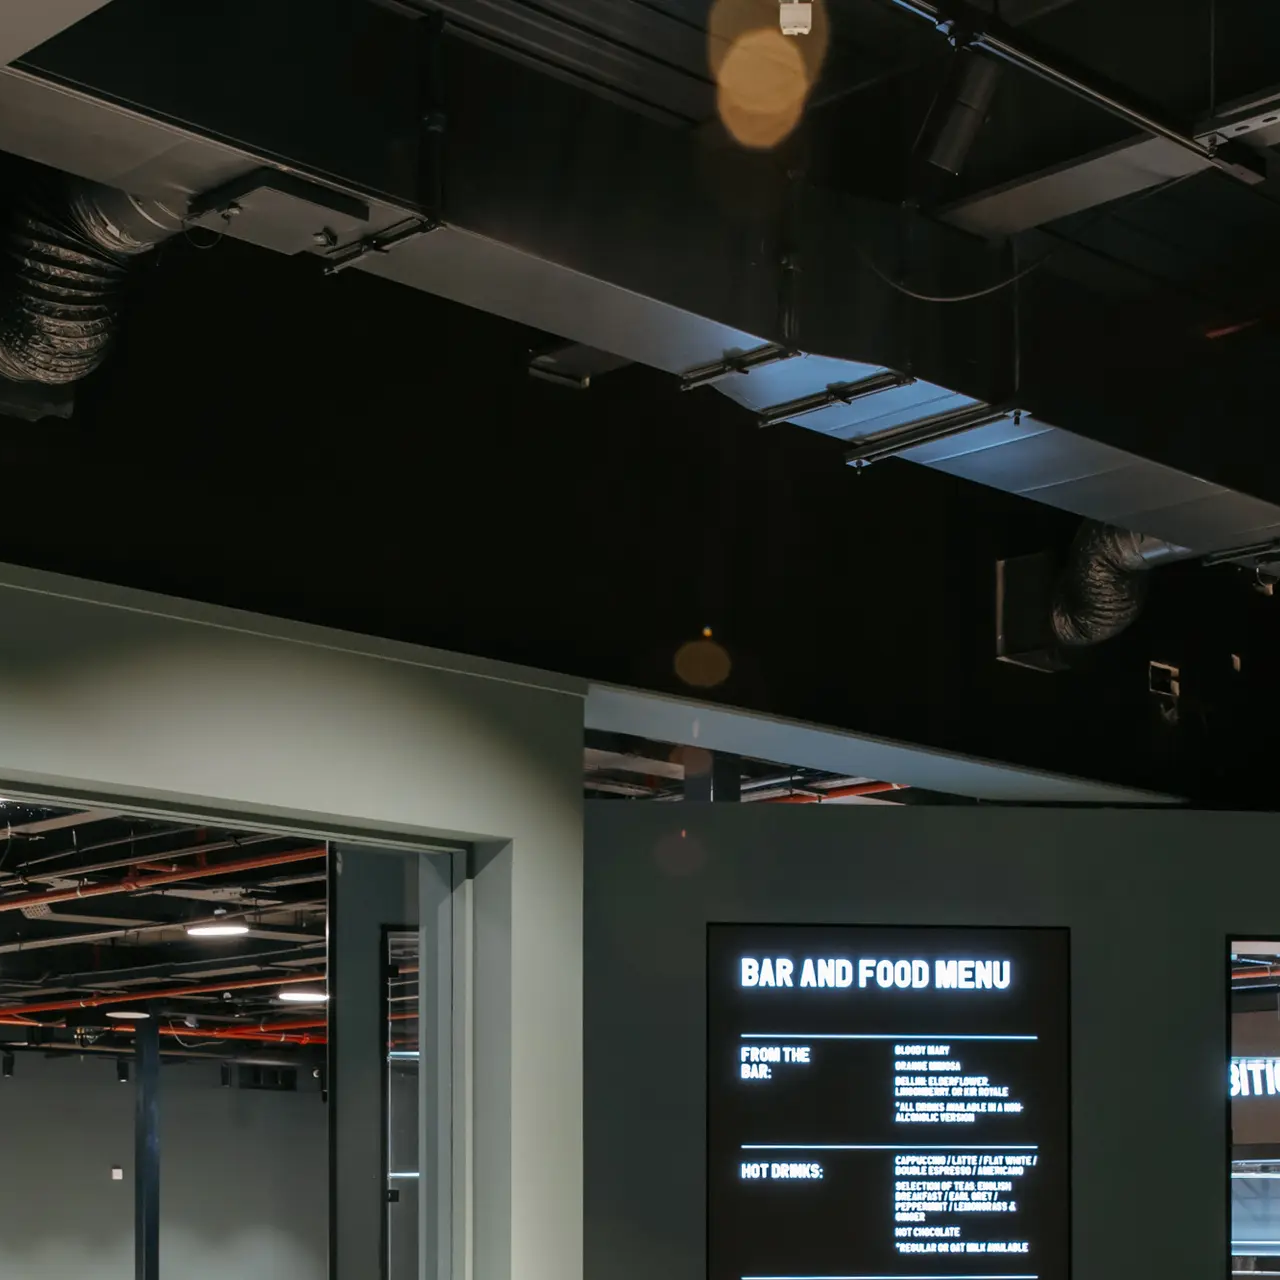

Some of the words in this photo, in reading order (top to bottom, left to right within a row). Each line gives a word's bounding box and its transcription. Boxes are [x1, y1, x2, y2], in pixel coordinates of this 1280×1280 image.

[742, 958, 793, 987] BAR
[800, 959, 853, 987] AND
[859, 959, 929, 988] FOOD
[935, 960, 1010, 988] MENU
[741, 1047, 780, 1062] FROM
[782, 1047, 810, 1062] THE
[741, 1064, 771, 1078] BAR:
[742, 1164, 769, 1178] HOT
[771, 1164, 823, 1178] DRINKS:
